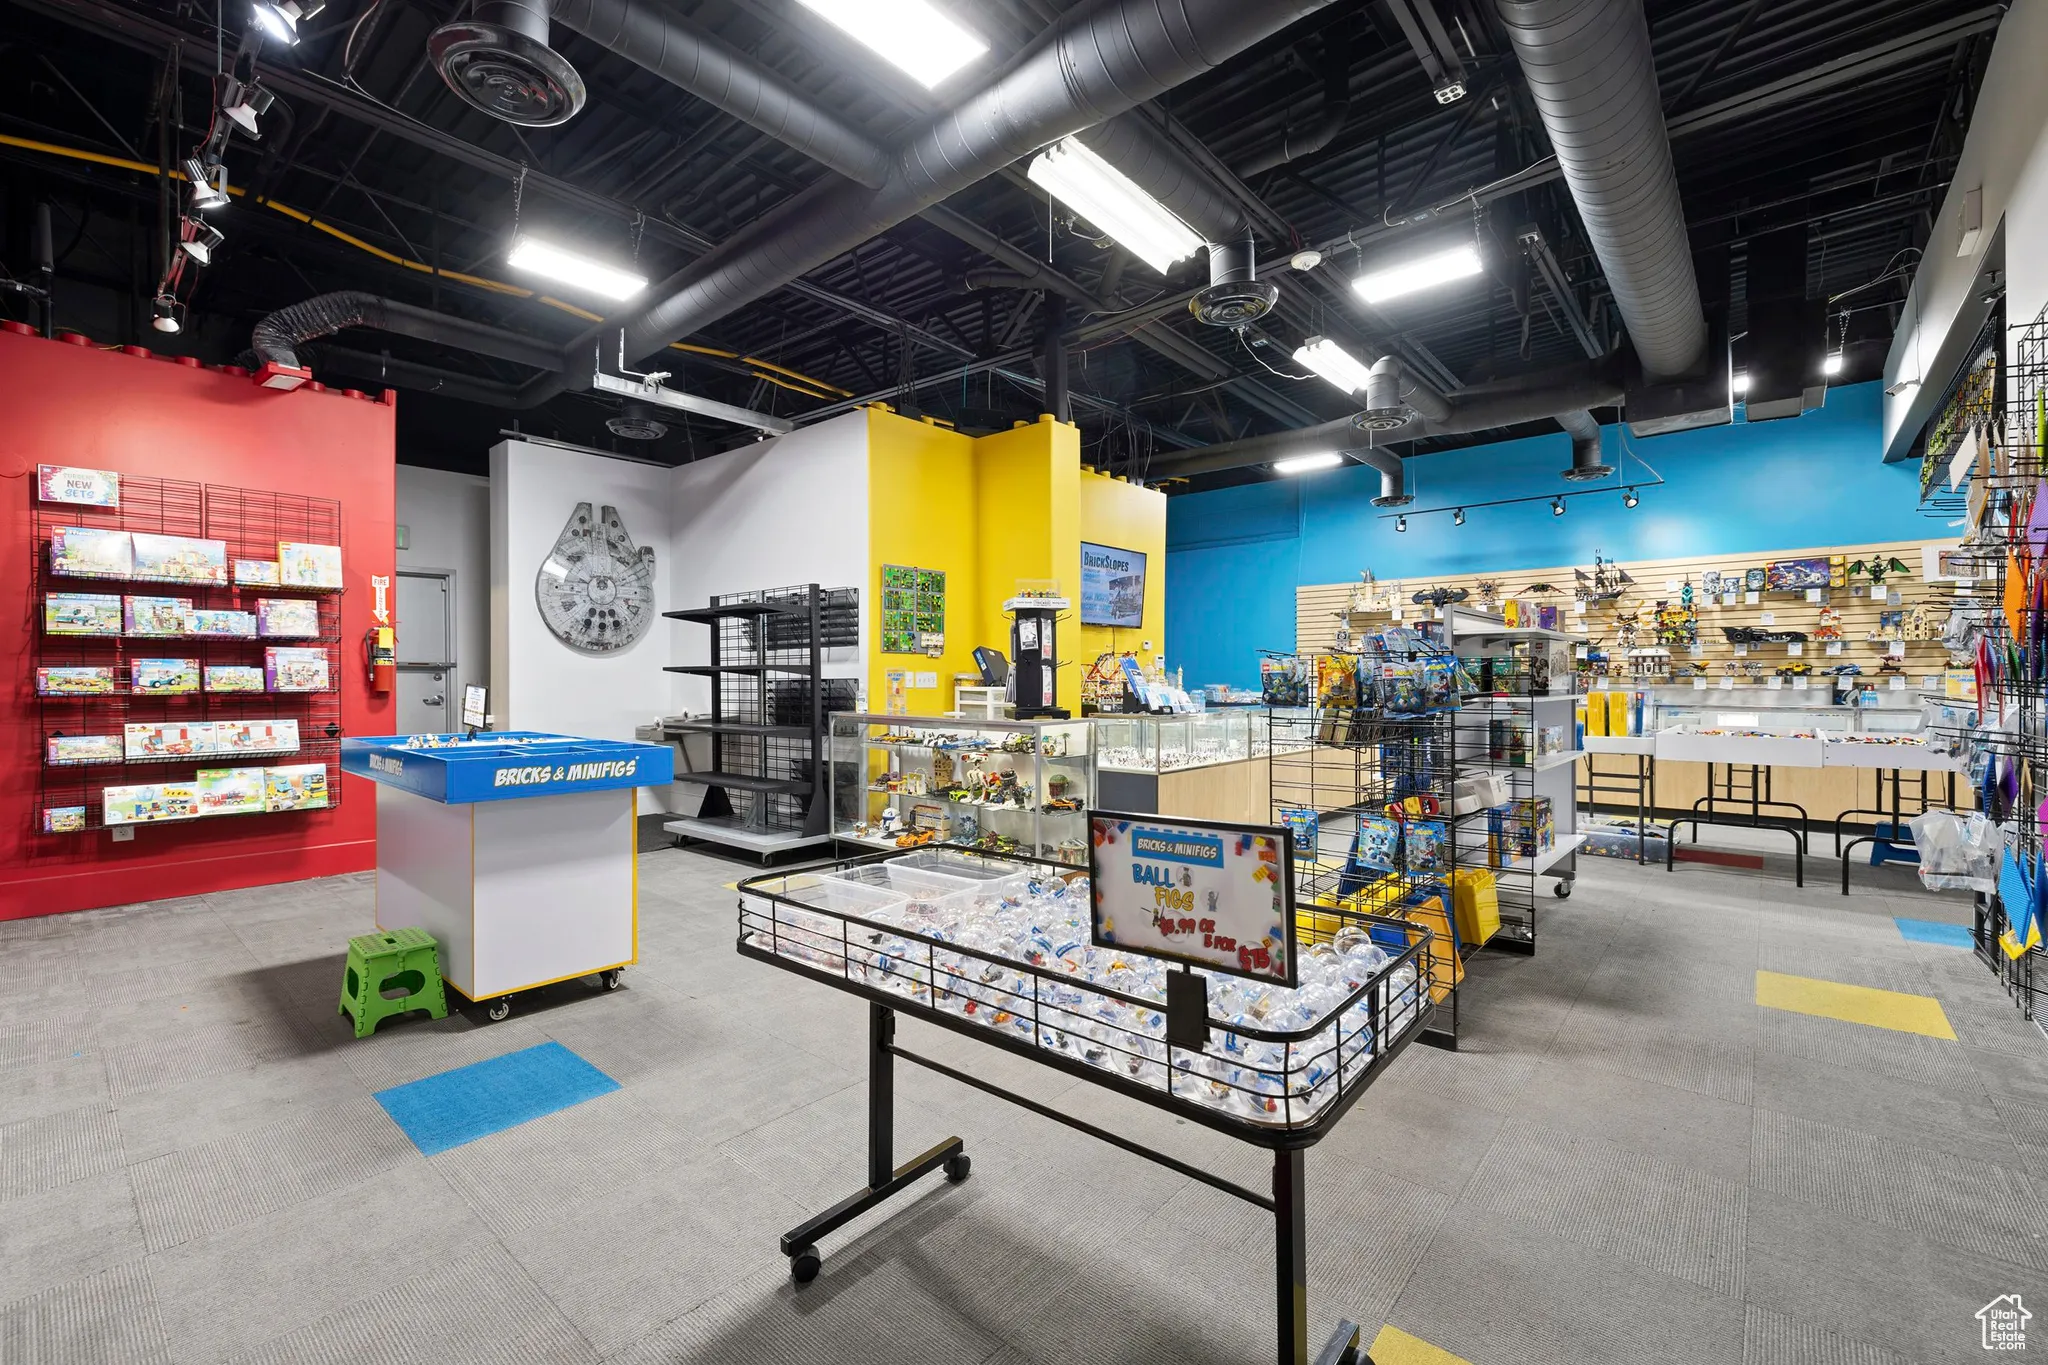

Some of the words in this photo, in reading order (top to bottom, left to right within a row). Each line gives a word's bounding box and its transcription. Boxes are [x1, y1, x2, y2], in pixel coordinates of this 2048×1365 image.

[65, 488, 95, 499] SETS
[66, 480, 93, 490] NEW
[373, 578, 387, 586] FIRE
[494, 765, 551, 787] BRICKS
[552, 766, 564, 781] &
[566, 759, 636, 781] MINIFIGS
[1137, 838, 1166, 852] BRICKS
[1167, 843, 1173, 852] &
[1174, 843, 1218, 859] MINIFIGS
[1132, 863, 1175, 888] BALL
[1154, 886, 1195, 911] FIGS
[1199, 918, 1216, 934] OR
[1213, 935, 1237, 953] FOR
